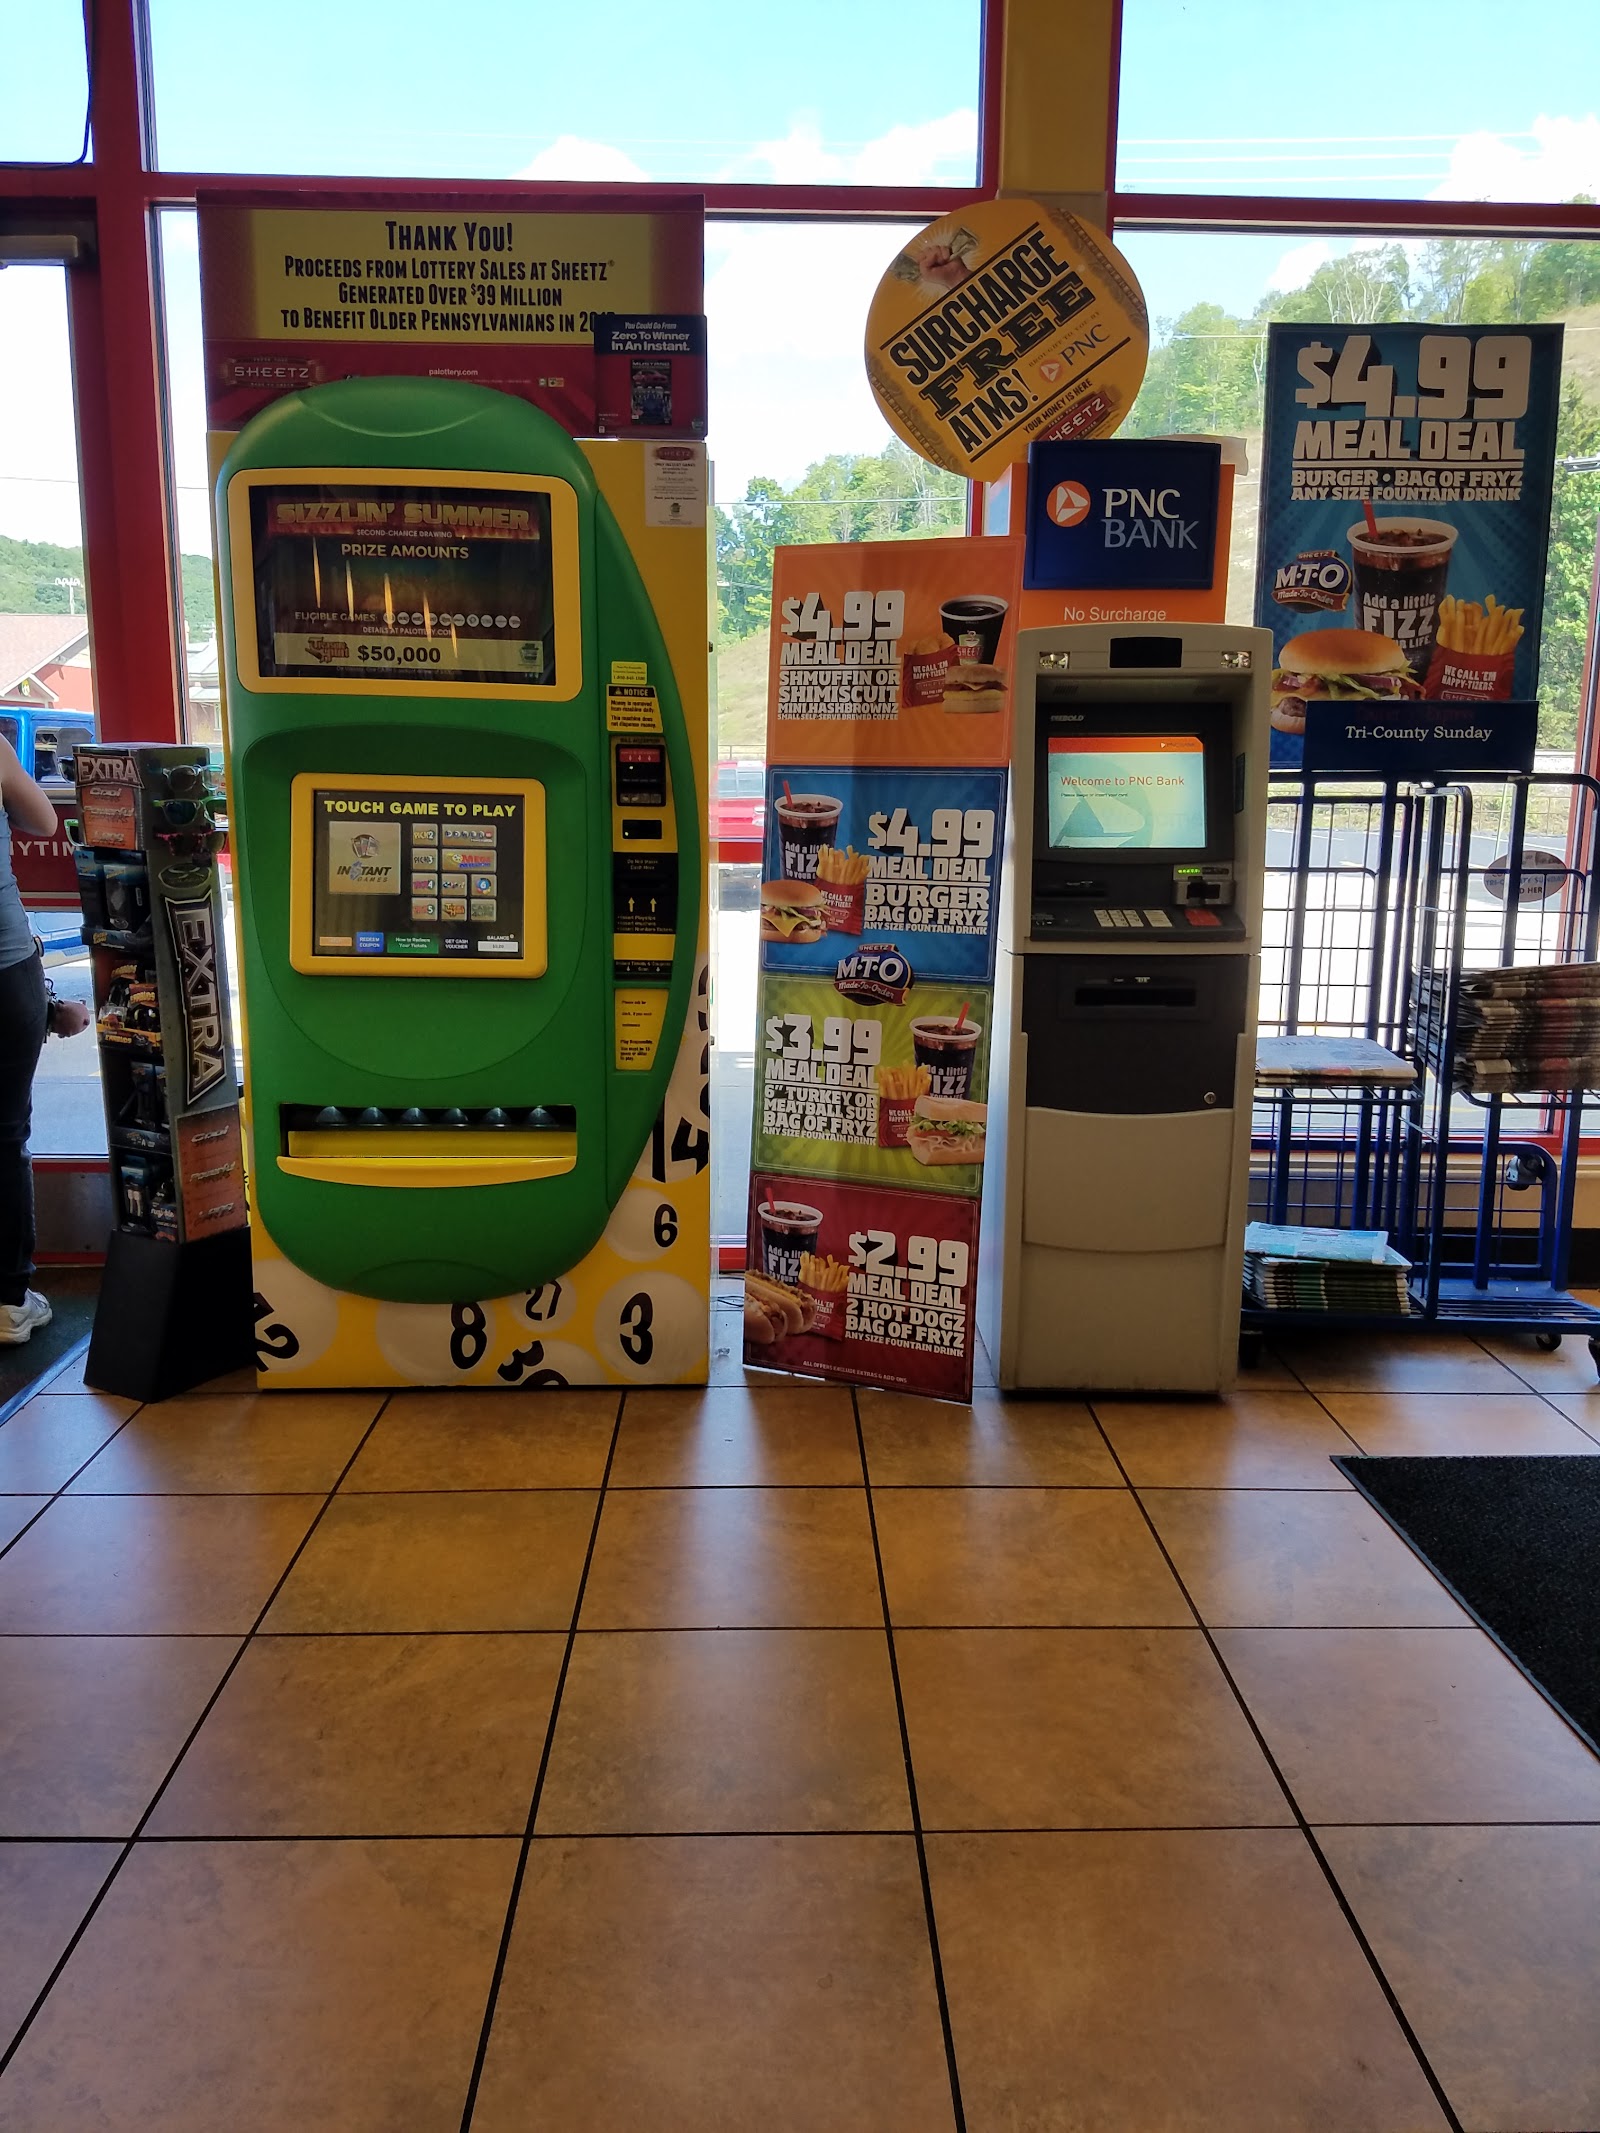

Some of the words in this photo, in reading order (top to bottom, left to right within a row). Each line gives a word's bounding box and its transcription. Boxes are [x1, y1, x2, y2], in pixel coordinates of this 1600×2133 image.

[471, 283, 496, 306] $39
[889, 230, 1070, 386] SURCHARGE
[611, 341, 624, 351] In
[625, 341, 642, 351] An
[643, 341, 690, 351] Instant.
[612, 331, 637, 340] Zero
[639, 332, 651, 340] To
[652, 332, 690, 340] Winner
[919, 271, 1096, 420] FREE
[1060, 324, 1111, 366] PNC
[234, 366, 309, 378] SHEETZ
[428, 368, 478, 377] palottery.com
[1295, 334, 1532, 419] $4.99
[1023, 416, 1043, 434] YOUR
[1041, 397, 1067, 420] MONEY
[1065, 392, 1075, 402] IS
[1074, 378, 1093, 395] HERE
[1293, 420, 1410, 460] MEAL
[1419, 421, 1525, 460] DEAL
[1292, 469, 1378, 487] BURGER
[1394, 470, 1436, 487] BAG
[1440, 470, 1465, 487] OF
[1469, 471, 1523, 487] FRYZ
[1102, 488, 1181, 519] PNC
[1291, 486, 1330, 500] ANY
[1332, 487, 1370, 500] SIZE
[1372, 487, 1461, 501] FOUNTAIN
[1463, 487, 1521, 501] DRINK
[403, 503, 530, 530] SUMMER
[357, 529, 418, 537] SECOND-CHANCE
[1101, 519, 1199, 550] BANK
[341, 543, 387, 557] PRIZE
[391, 545, 469, 559] AMOUNTS
[1363, 592, 1387, 609] Add
[1391, 599, 1400, 609] a
[1404, 593, 1435, 609] little
[780, 590, 905, 641] $4.99
[1064, 607, 1085, 621] No
[1089, 607, 1166, 623] Surcharge
[1363, 606, 1434, 639] FIZZ
[357, 645, 441, 664] $50,000
[780, 642, 840, 665] MEAL
[845, 641, 902, 664] DEAL
[779, 670, 873, 686] SHMUFFIN
[876, 670, 900, 685] OR
[1445, 665, 1457, 677] WE
[1457, 669, 1479, 680] CALL
[624, 688, 648, 696] NOTICE
[779, 685, 900, 703] SHIMISCUIT
[778, 703, 806, 714] MINI
[808, 703, 899, 714] HASHBROWNZ
[1345, 726, 1429, 742] Tri-County
[1434, 726, 1493, 742] Sunday
[77, 756, 139, 782] EXTRA
[1061, 776, 1111, 786] Welcome
[1114, 777, 1125, 786] to
[1129, 777, 1153, 786] PNC
[1156, 776, 1185, 786] Bank
[324, 800, 384, 814] TOUCH
[390, 801, 439, 816] GAME
[444, 803, 467, 816] TO
[472, 804, 516, 817] PLAY
[868, 808, 995, 858] $4.99
[785, 841, 800, 853] Add
[802, 846, 807, 854] a
[785, 850, 818, 873] FIZ
[867, 857, 928, 881] MEAL
[932, 858, 991, 883] DEAL
[865, 884, 990, 910] BURGER
[864, 906, 905, 923] BAG
[908, 907, 935, 924] OF
[937, 908, 988, 927] FRYZ
[864, 921, 883, 930] ANY
[884, 922, 904, 932] SIZE
[905, 923, 955, 934] FOUNTAIN
[956, 926, 988, 935] DRINK
[175, 908, 222, 1088] EXTRA
[765, 1013, 882, 1065] $3.99
[765, 1058, 822, 1084] MEAL
[826, 1065, 880, 1089] DEAL
[947, 1066, 968, 1076] little
[787, 1086, 852, 1107] TURKEY
[855, 1094, 878, 1109] OR
[764, 1098, 843, 1119] MEATBALL
[846, 1107, 877, 1121] SUB
[762, 1126, 781, 1136] ANY
[782, 1129, 800, 1139] SIZE
[801, 1130, 846, 1142] FOUNTAIN
[848, 1134, 877, 1146] DRINK
[763, 1111, 800, 1130] BAG
[804, 1115, 827, 1132] OF
[831, 1117, 877, 1138] FRYZ
[653, 1203, 678, 1248] 6
[768, 1244, 782, 1256] Add
[848, 1229, 969, 1287] $2.99
[768, 1253, 799, 1276] FIZ
[849, 1273, 906, 1301] MEAL
[911, 1284, 966, 1311] DEAL
[847, 1299, 858, 1314] 2
[863, 1302, 906, 1318] HOT
[910, 1309, 965, 1332] DOGZ
[450, 1301, 487, 1369] 8
[619, 1292, 653, 1365] 3
[846, 1315, 885, 1336] BAG
[888, 1322, 912, 1339] OF
[915, 1328, 965, 1348] FRYZ
[845, 1331, 864, 1341] ANY
[865, 1334, 884, 1344] SIZE
[885, 1337, 932, 1352] FOUNTAIN
[933, 1344, 964, 1358] DRINK
